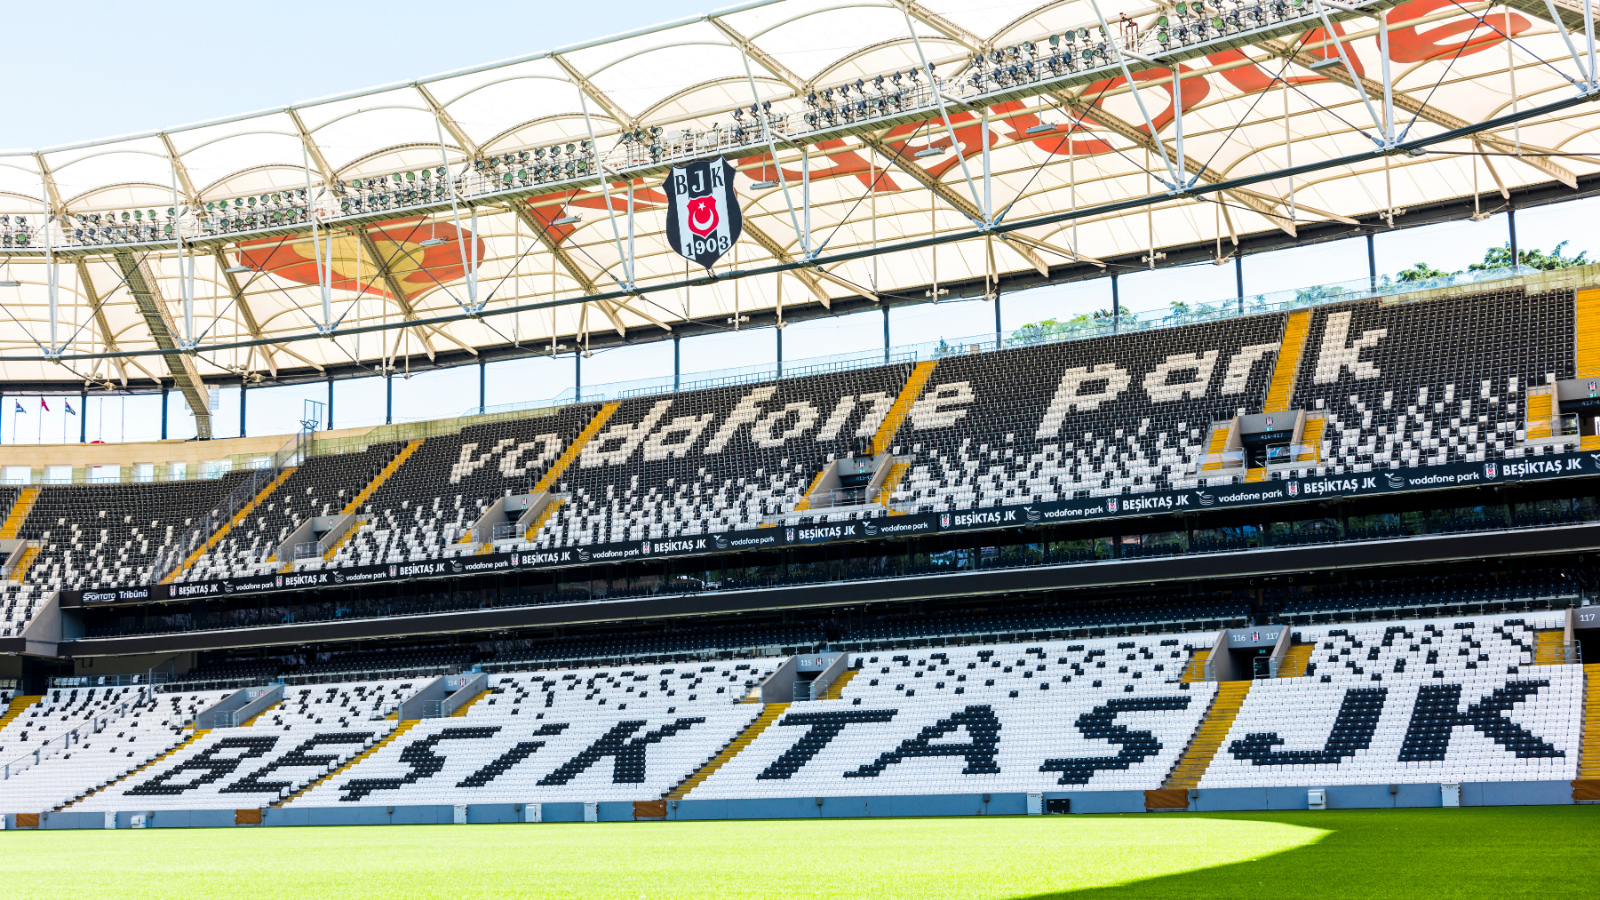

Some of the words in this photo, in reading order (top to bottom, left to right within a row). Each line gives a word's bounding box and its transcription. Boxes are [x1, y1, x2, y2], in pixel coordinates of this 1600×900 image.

[675, 166, 724, 195] BJK
[686, 236, 729, 257] 1903
[449, 381, 977, 484] vodafone
[1036, 311, 1388, 439] park
[1566, 458, 1582, 470] JK
[1362, 477, 1376, 489] JK
[1409, 474, 1455, 486] vodafone
[1457, 471, 1480, 484] park
[1175, 494, 1189, 507] JK
[1218, 492, 1261, 504] vodafone
[1262, 490, 1283, 502] park
[1003, 510, 1016, 522] JK
[1044, 507, 1083, 518] vodafone
[1084, 505, 1103, 517] park
[842, 525, 855, 536] JK
[881, 523, 911, 533] vodafone
[913, 521, 928, 531] park
[695, 539, 707, 549] JK
[730, 537, 759, 546] vodafone
[760, 535, 774, 545] park
[559, 551, 571, 562] JK
[592, 550, 623, 559] vodafone
[624, 548, 640, 558] park
[435, 562, 445, 572] JK
[464, 561, 493, 570] vodafone
[494, 559, 509, 569] park
[318, 573, 328, 583] JK
[346, 572, 372, 581] vodafone
[373, 570, 387, 579] park
[209, 583, 219, 593] JK
[236, 582, 260, 591] vodafone
[261, 581, 274, 590] park
[119, 590, 148, 599] Tribünü
[1266, 632, 1279, 640] 117
[1228, 679, 1566, 766] JK
